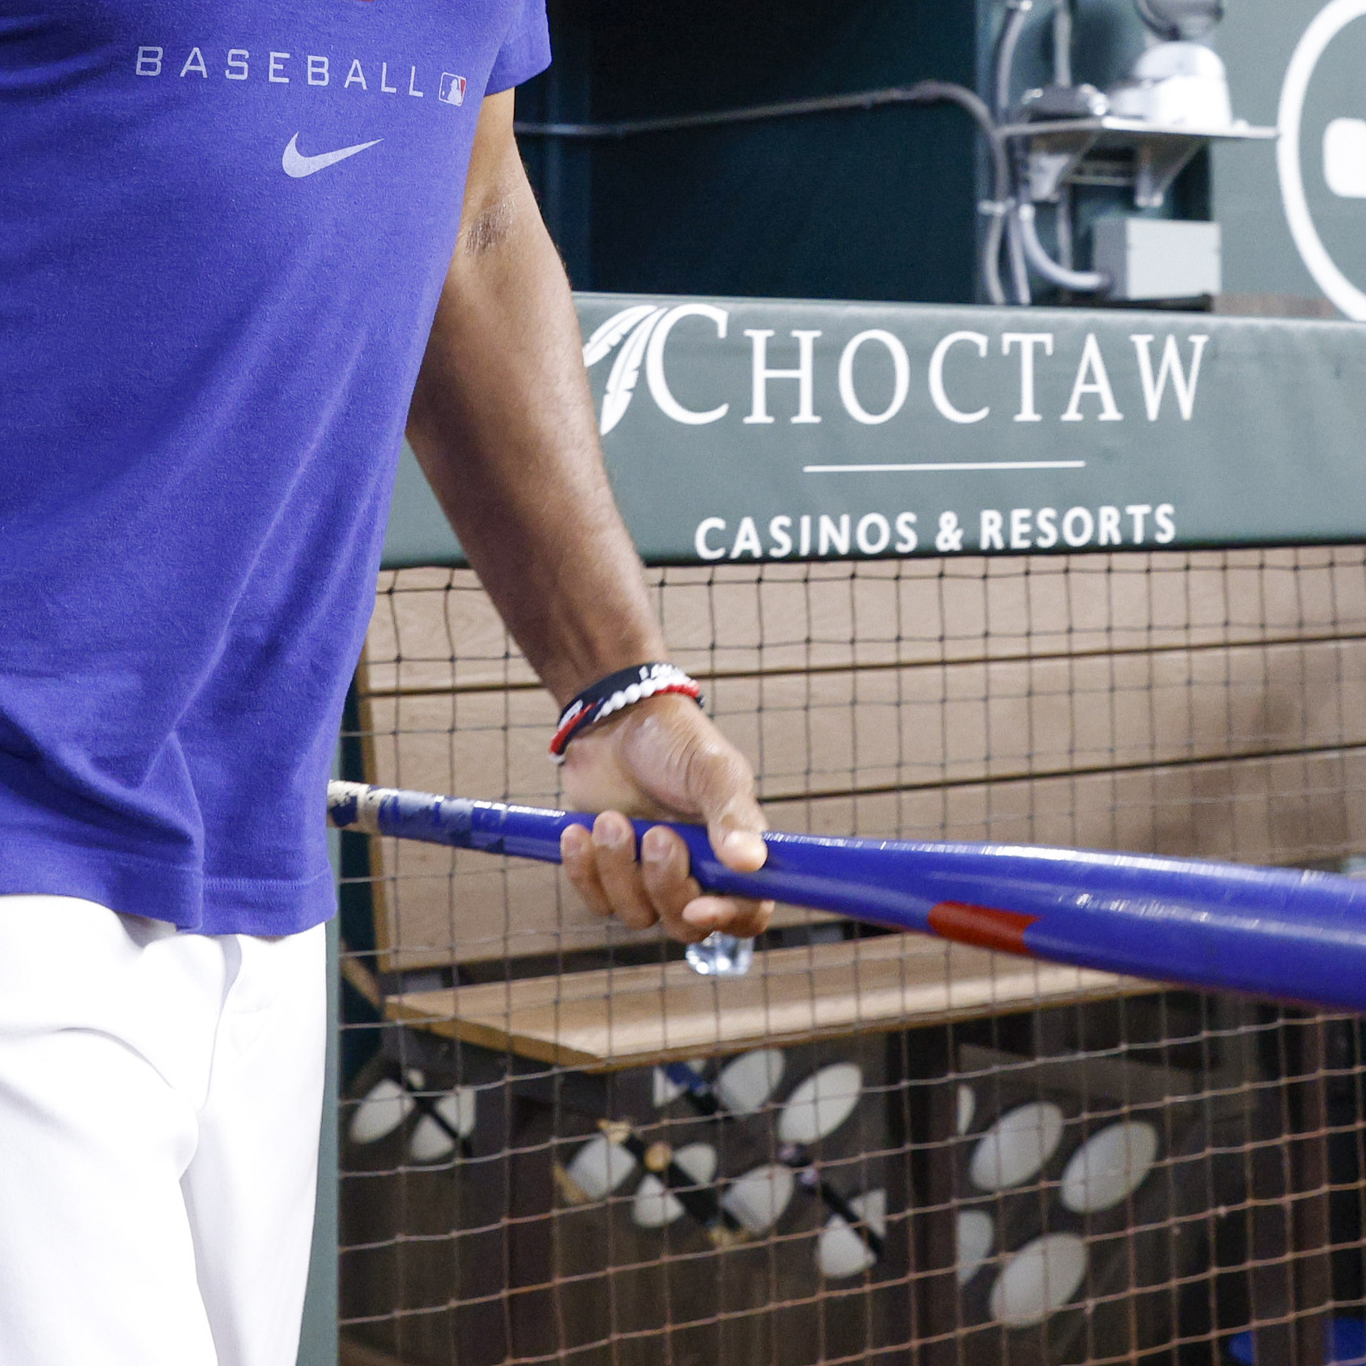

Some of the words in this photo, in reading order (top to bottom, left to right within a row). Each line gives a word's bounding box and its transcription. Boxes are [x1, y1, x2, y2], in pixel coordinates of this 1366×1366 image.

[135, 46, 424, 97] BASEBALL
[646, 303, 1209, 425] CHOCTAW
[694, 512, 919, 561] CASINOS
[935, 511, 964, 552] &
[979, 504, 1176, 550] RESORTS
